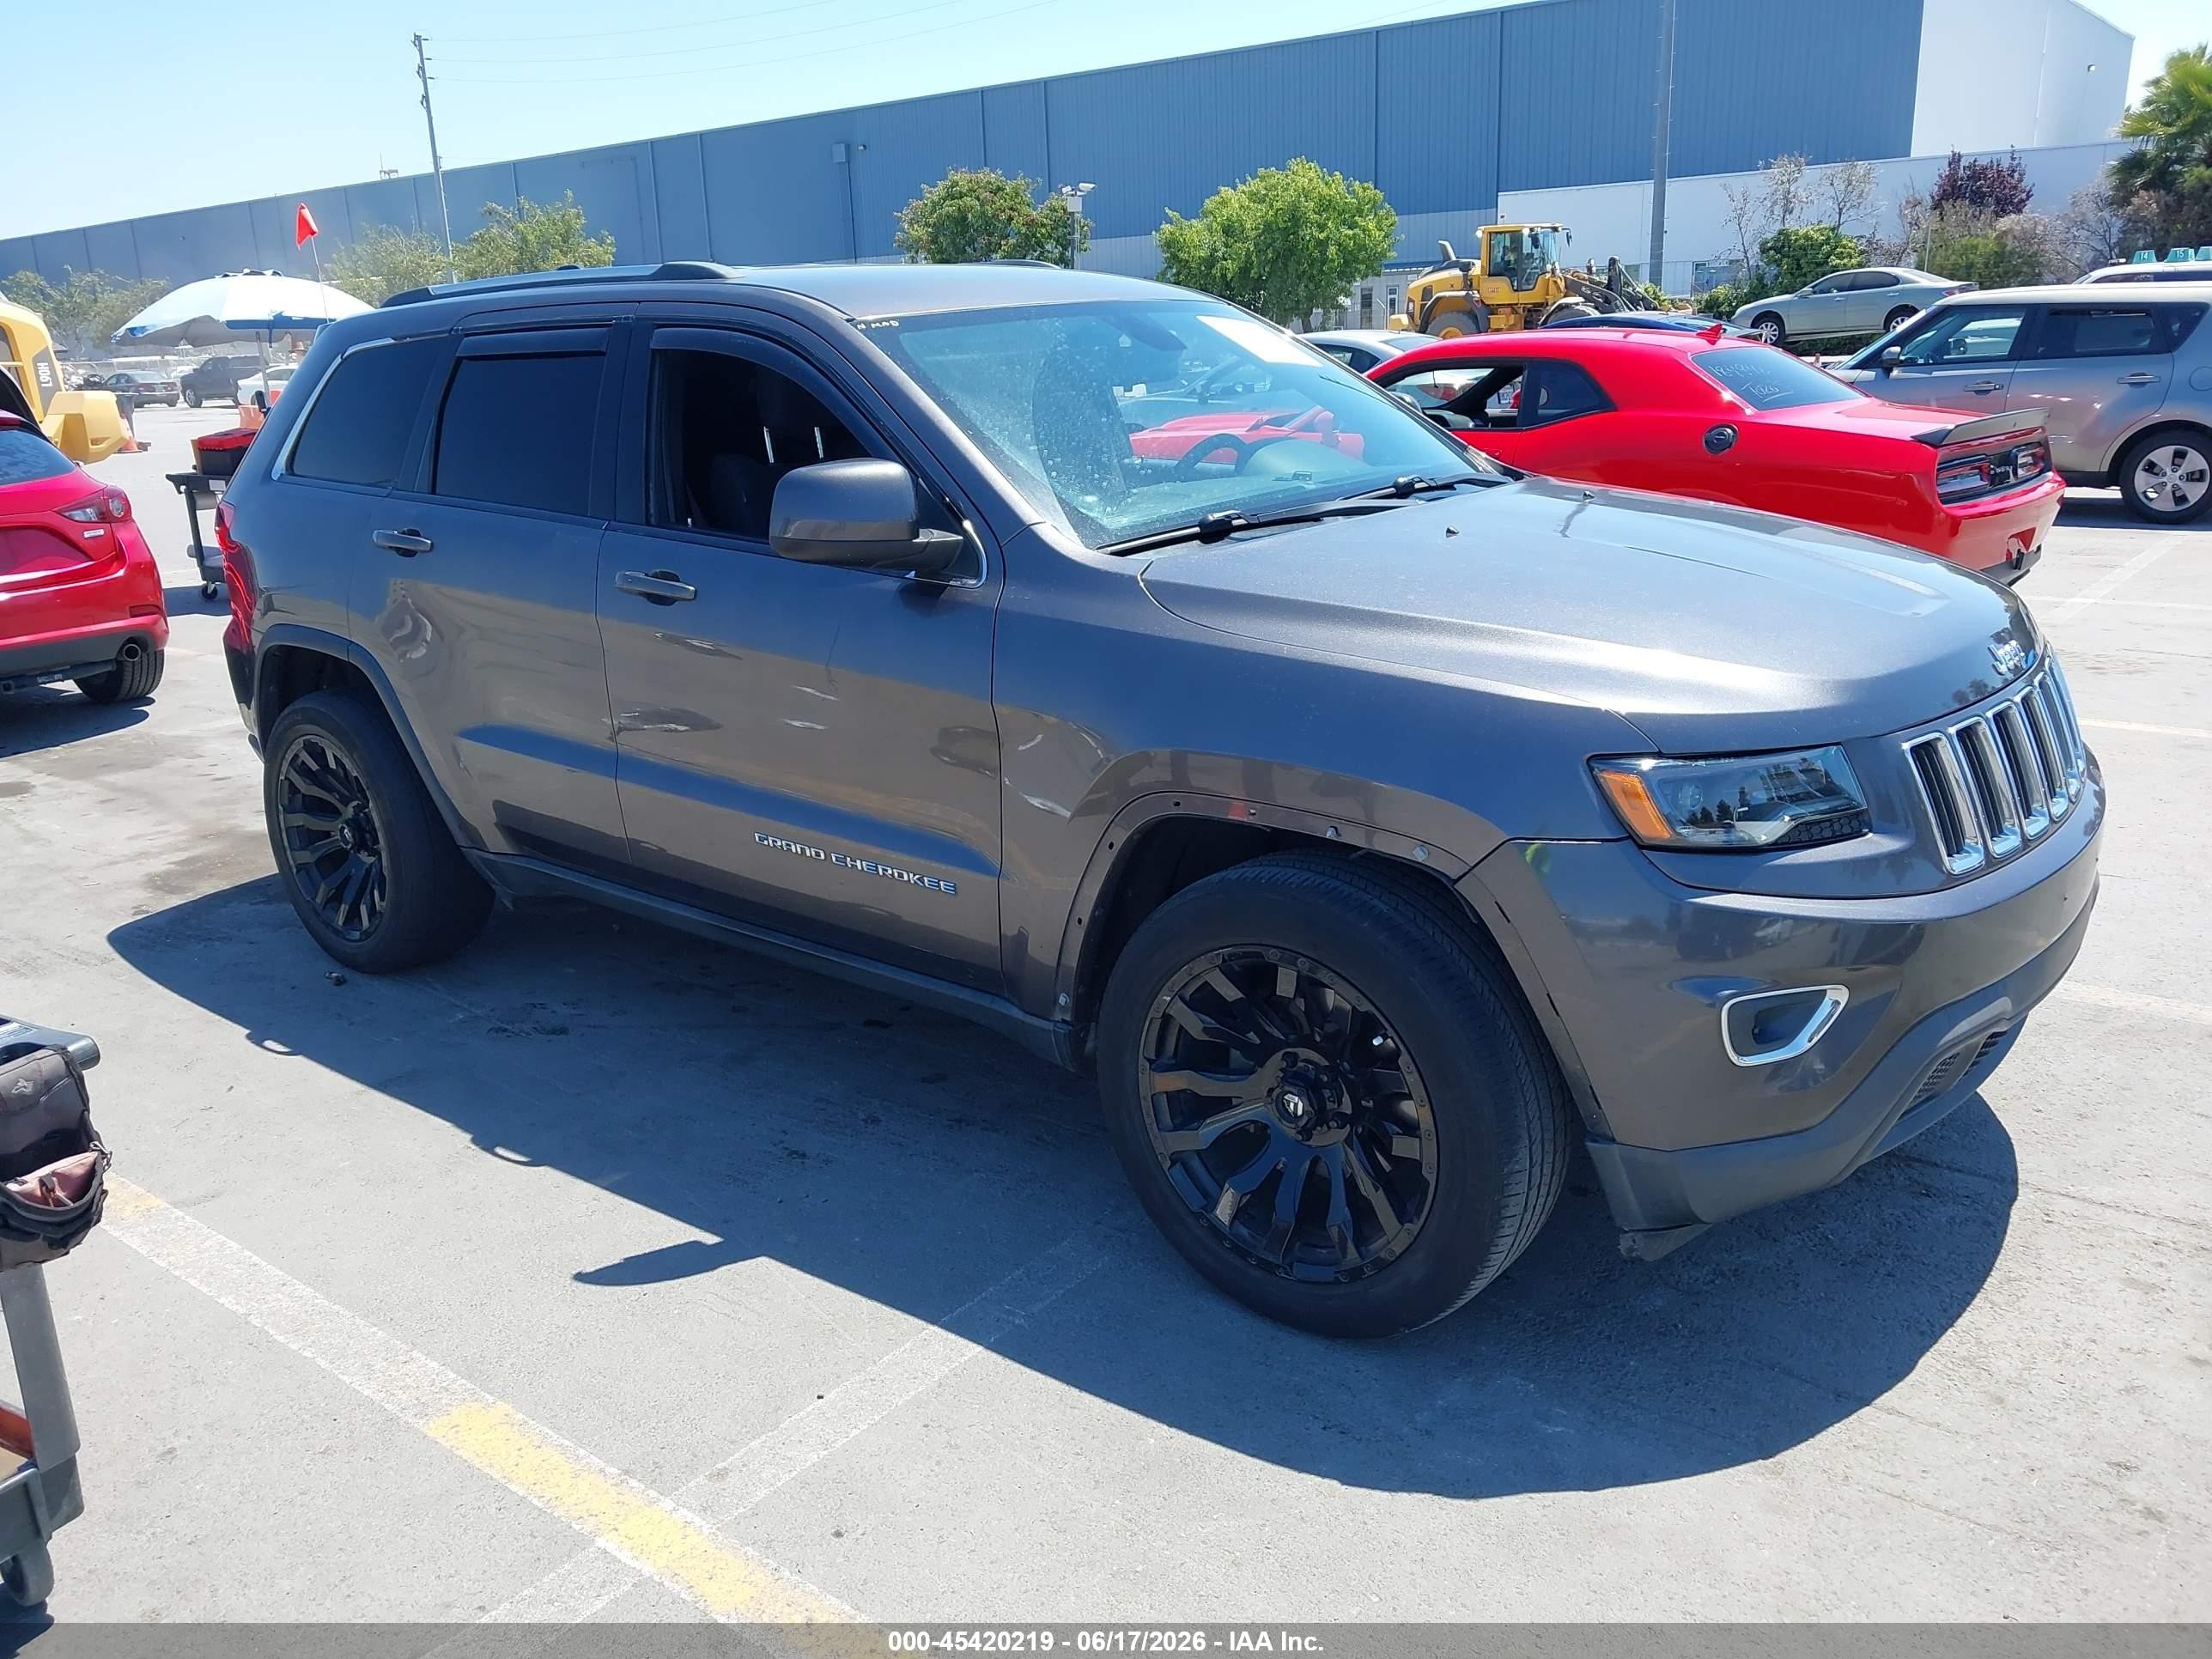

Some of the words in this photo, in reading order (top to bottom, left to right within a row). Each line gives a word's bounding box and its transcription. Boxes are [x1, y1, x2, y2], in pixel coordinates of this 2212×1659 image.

[2176, 250, 2185, 258] 15
[36, 362, 53, 387] L90H
[754, 831, 826, 860] GRAND
[830, 852, 957, 895] CHEROKEE
